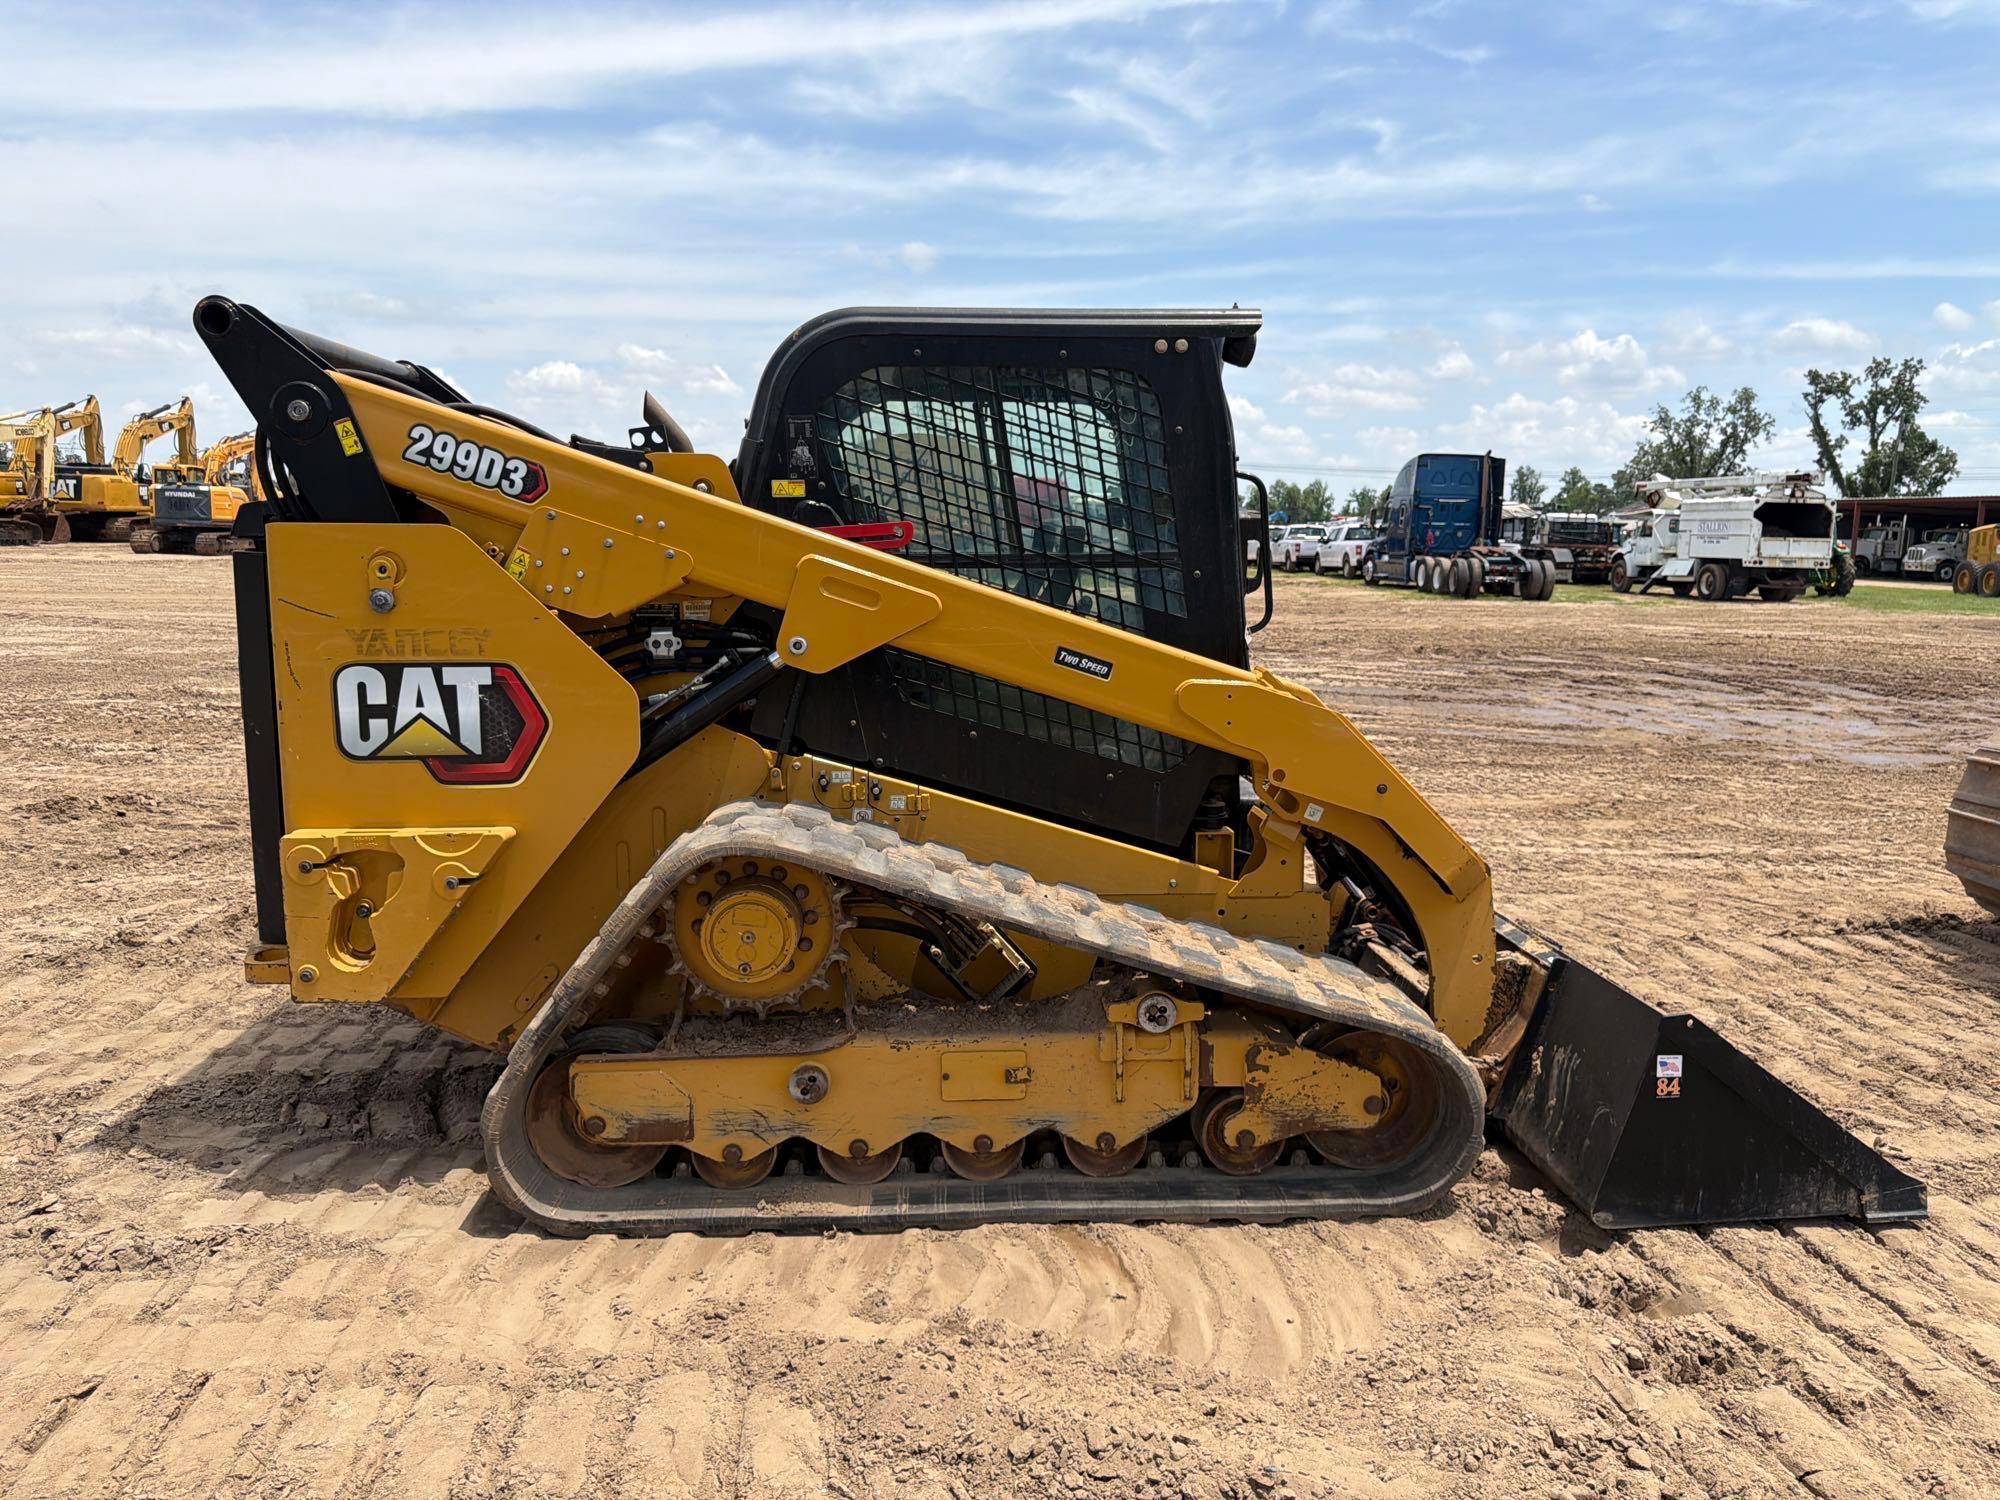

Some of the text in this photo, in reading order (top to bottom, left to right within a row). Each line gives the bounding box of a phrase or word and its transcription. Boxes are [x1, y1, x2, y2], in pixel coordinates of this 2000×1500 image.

[404, 426, 528, 496] 299D3
[164, 490, 196, 498] HYUNDAI
[1697, 521, 1728, 532] STALLION
[336, 665, 492, 757] CAT
[1656, 1077, 1681, 1096] 84
